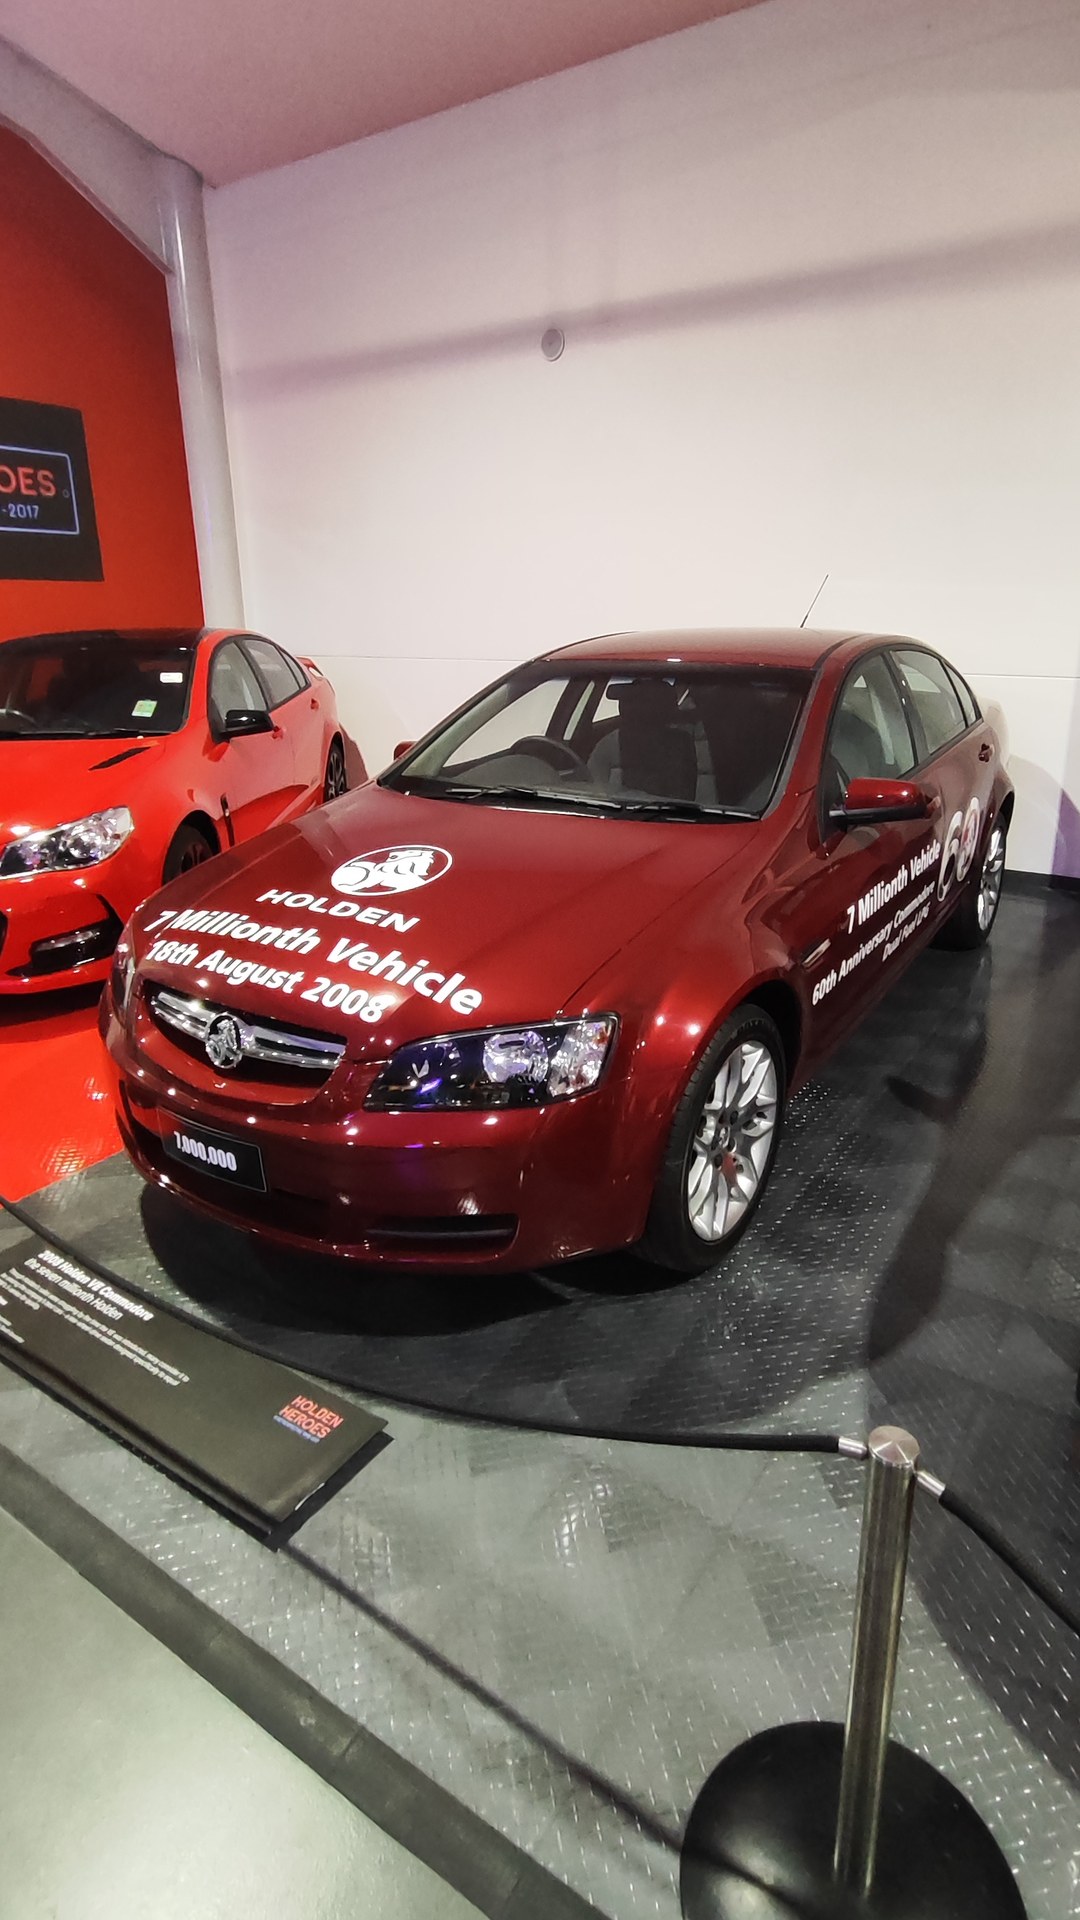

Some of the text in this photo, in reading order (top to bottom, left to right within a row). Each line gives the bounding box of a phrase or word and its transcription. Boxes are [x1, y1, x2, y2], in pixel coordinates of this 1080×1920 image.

[256, 889, 420, 933] HOLDEN
[847, 839, 942, 934] 7 Millionth Vehicle
[144, 909, 483, 1015] 7 Millionth Vehicle
[146, 939, 390, 1023] 18th August 2008
[812, 965, 837, 1006] 60th
[838, 919, 893, 982] Anniversary
[57, 1261, 91, 1285] Holden
[99, 1286, 154, 1321] Commodore
[90, 1298, 124, 1321] Holden
[279, 1405, 332, 1438] HEROES
[291, 1395, 344, 1429] HOLDEN
